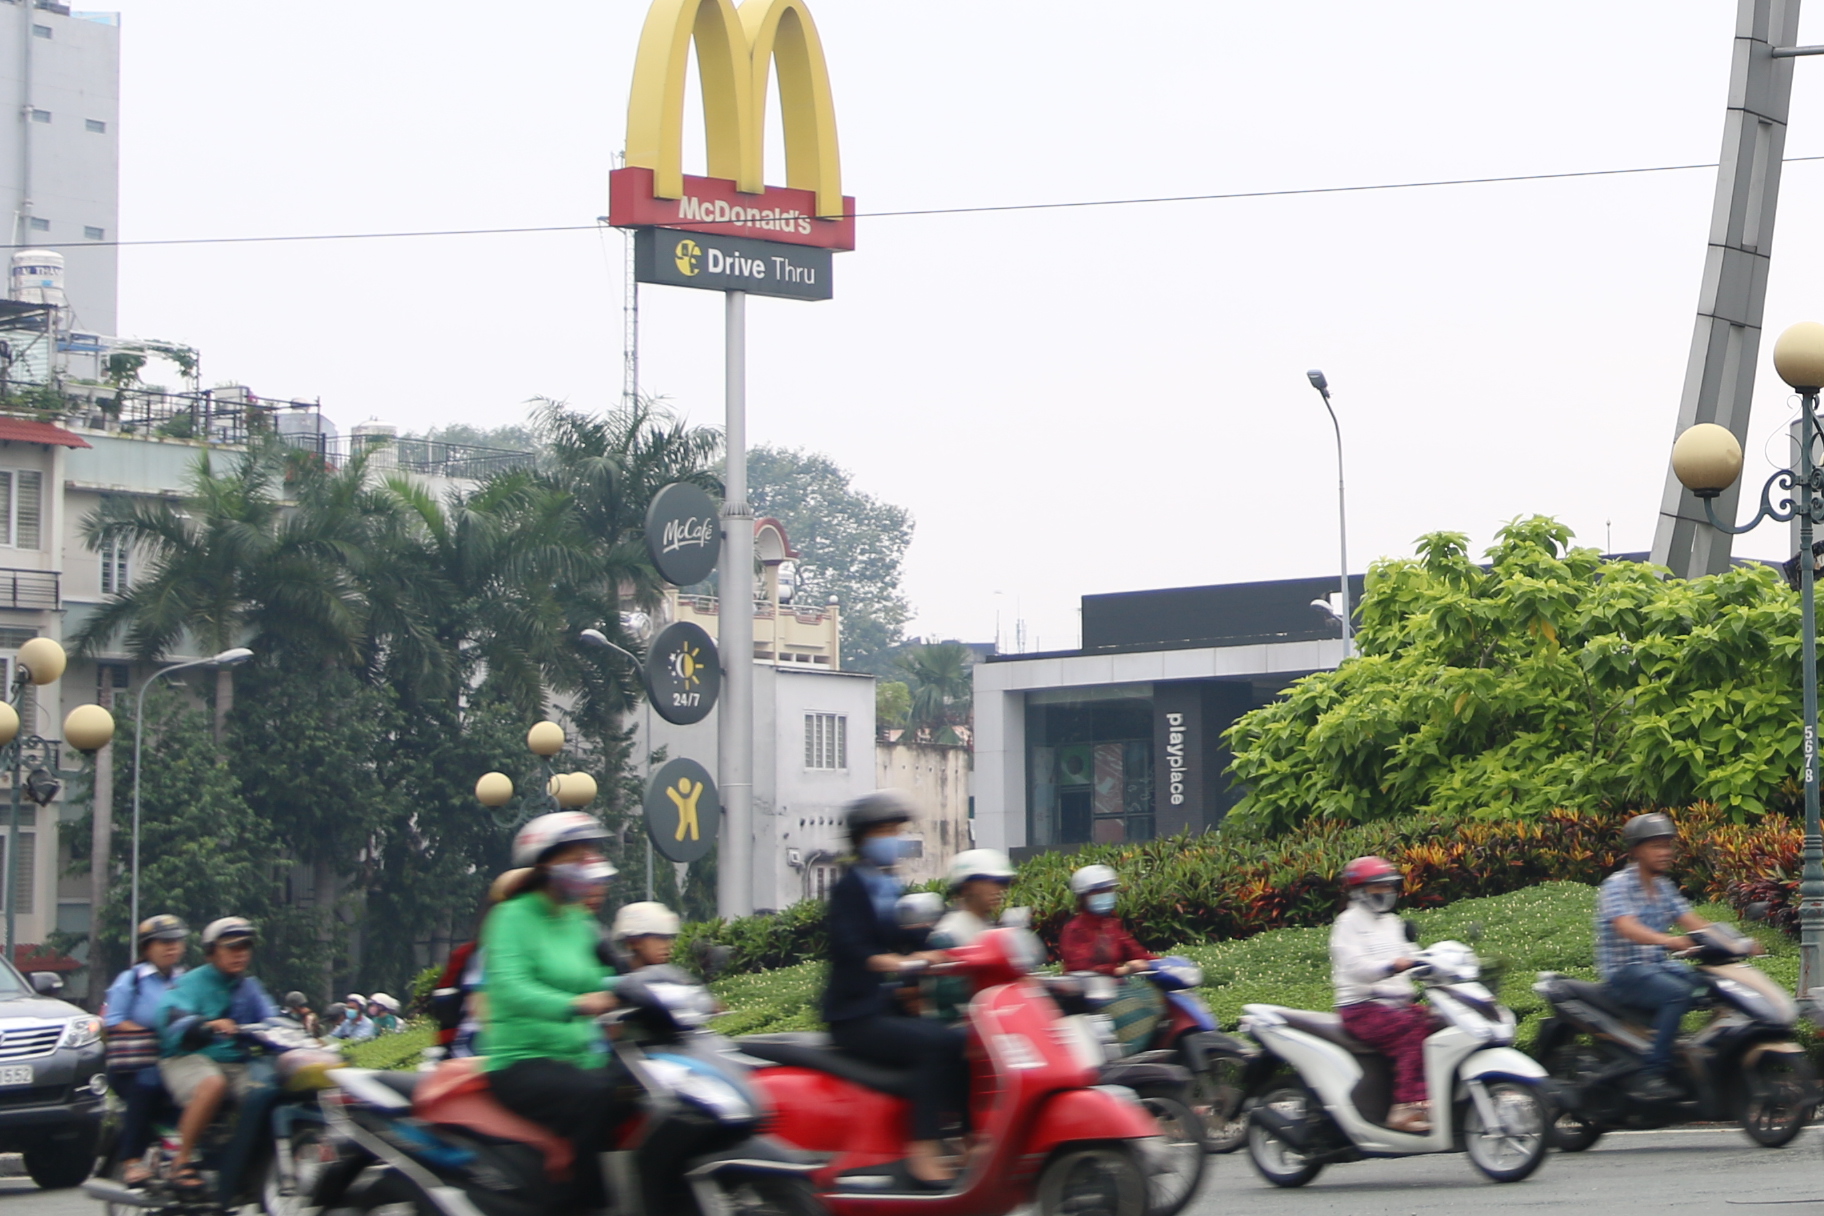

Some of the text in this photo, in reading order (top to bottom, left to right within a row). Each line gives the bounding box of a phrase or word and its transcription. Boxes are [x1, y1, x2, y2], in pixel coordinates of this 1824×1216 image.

[678, 195, 812, 235] McDonald's
[708, 248, 816, 285] Drive Thru
[673, 692, 701, 708] 24/7
[1166, 713, 1188, 805] playplace
[1804, 725, 1814, 783] 5678
